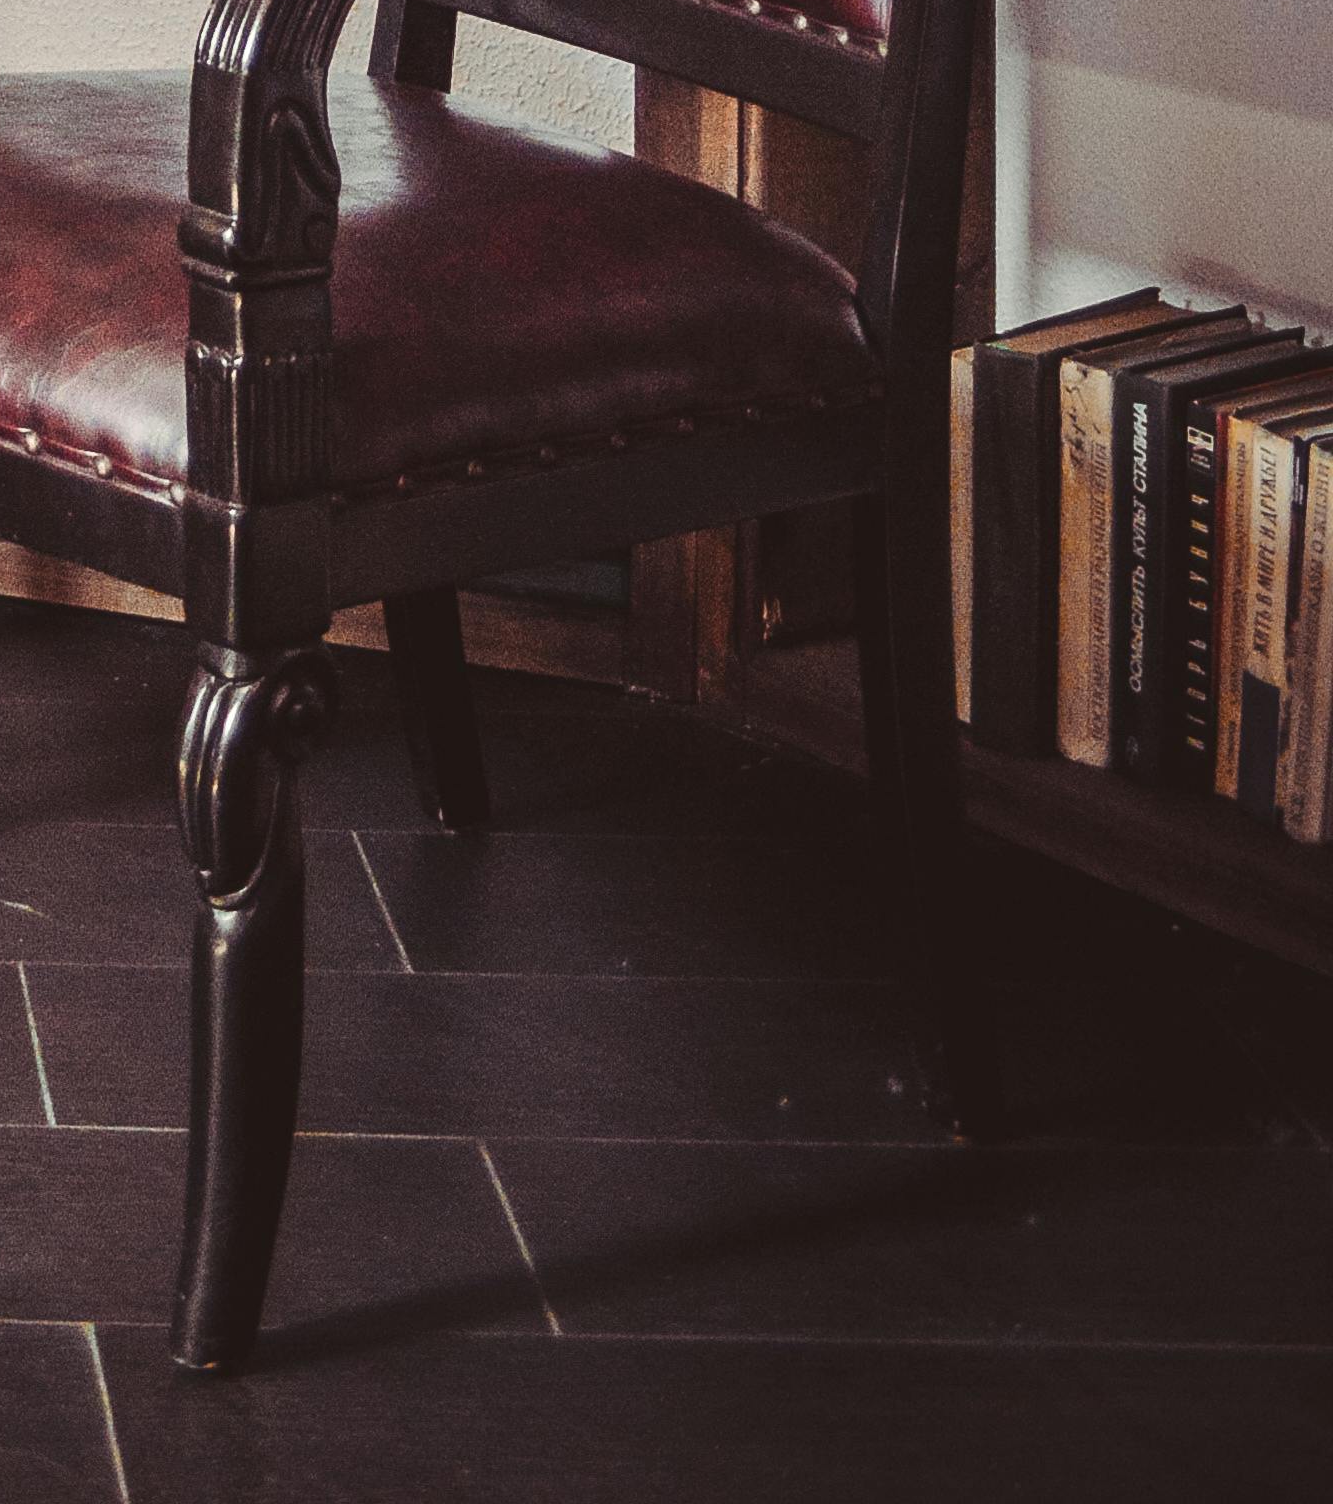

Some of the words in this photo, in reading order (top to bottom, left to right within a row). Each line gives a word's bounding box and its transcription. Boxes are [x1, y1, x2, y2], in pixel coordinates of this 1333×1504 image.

[1132, 402, 1148, 494] СТАЛИНА
[1132, 498, 1147, 558] КУЛЬТ
[1188, 493, 1209, 612] БУНИЧ
[1257, 542, 1275, 590] МИРЕ
[1129, 565, 1146, 693] ОСМЫСЛИТЬ
[1252, 608, 1273, 659] ЖИТЬ
[1257, 595, 1273, 607] В
[1186, 638, 1207, 751] ИГОРЬ
